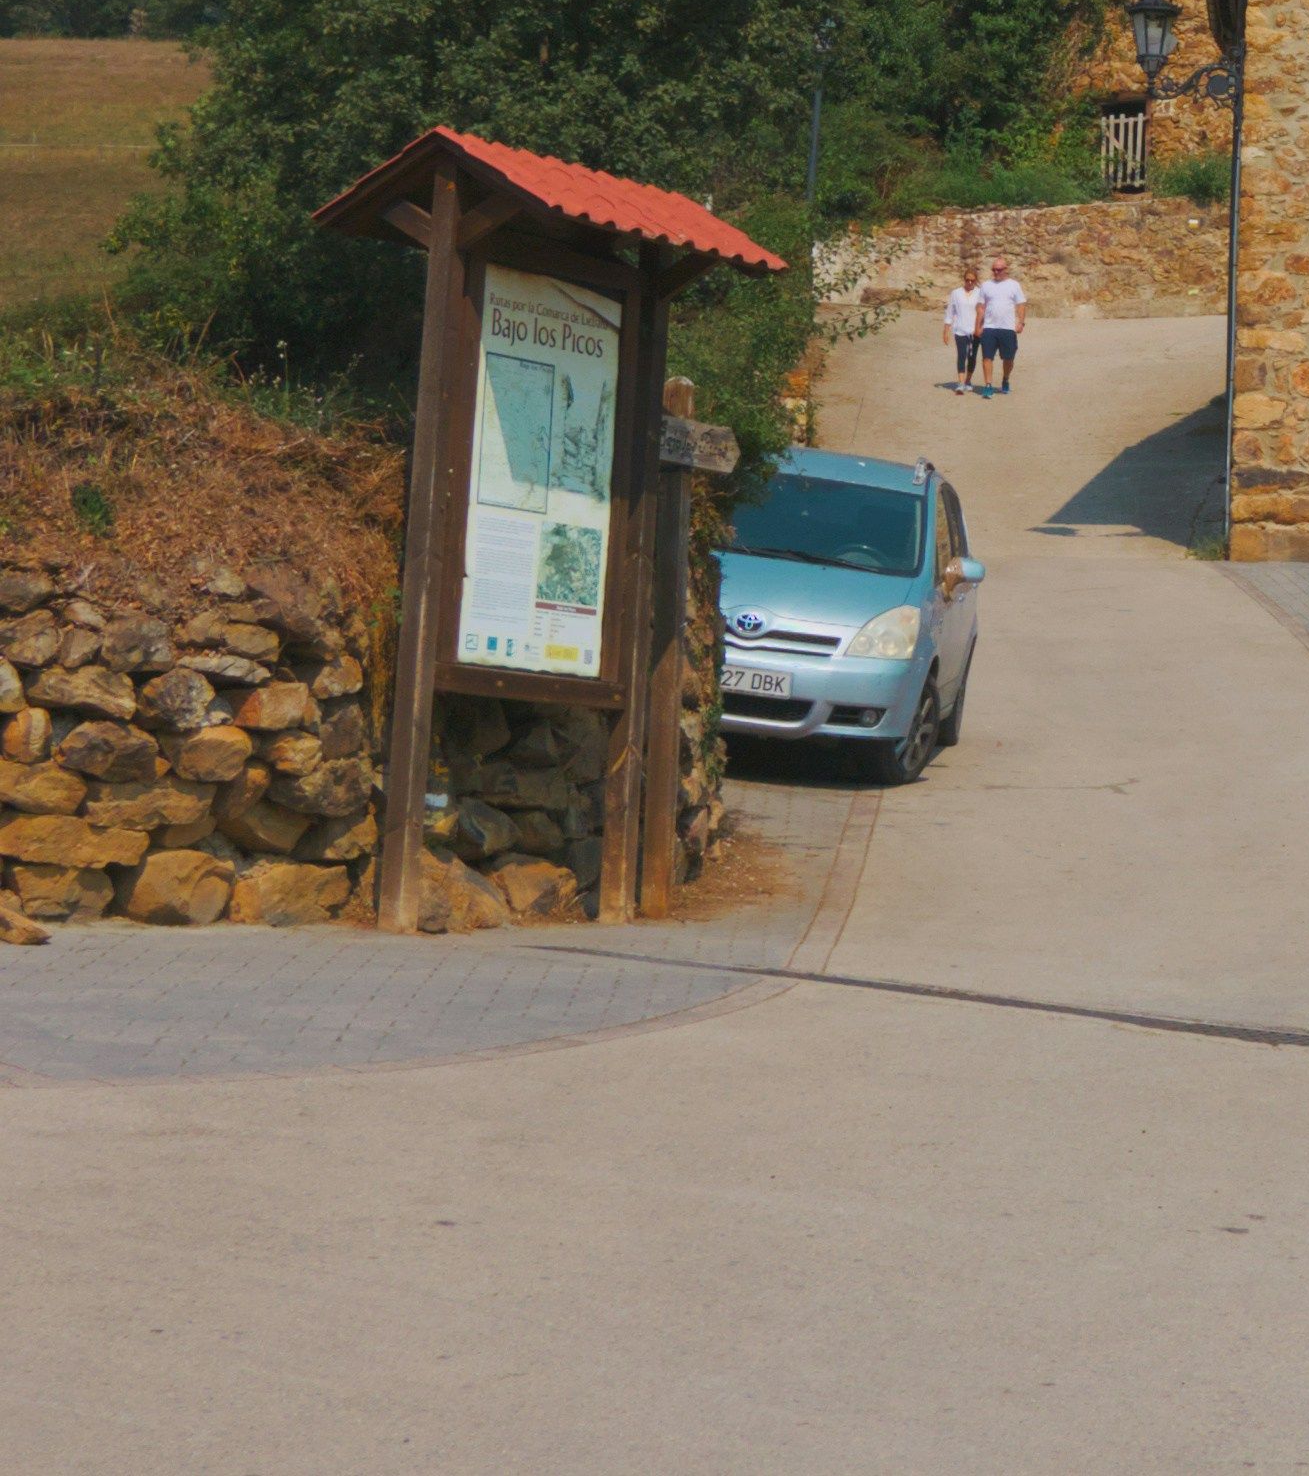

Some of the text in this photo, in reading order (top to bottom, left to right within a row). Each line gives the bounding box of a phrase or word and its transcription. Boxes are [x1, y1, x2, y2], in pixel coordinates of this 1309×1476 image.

[512, 301, 524, 311] por
[528, 301, 535, 314] la
[537, 304, 569, 321] Comarca
[491, 307, 603, 358] Bajo los Picos
[751, 673, 786, 693] DBK
